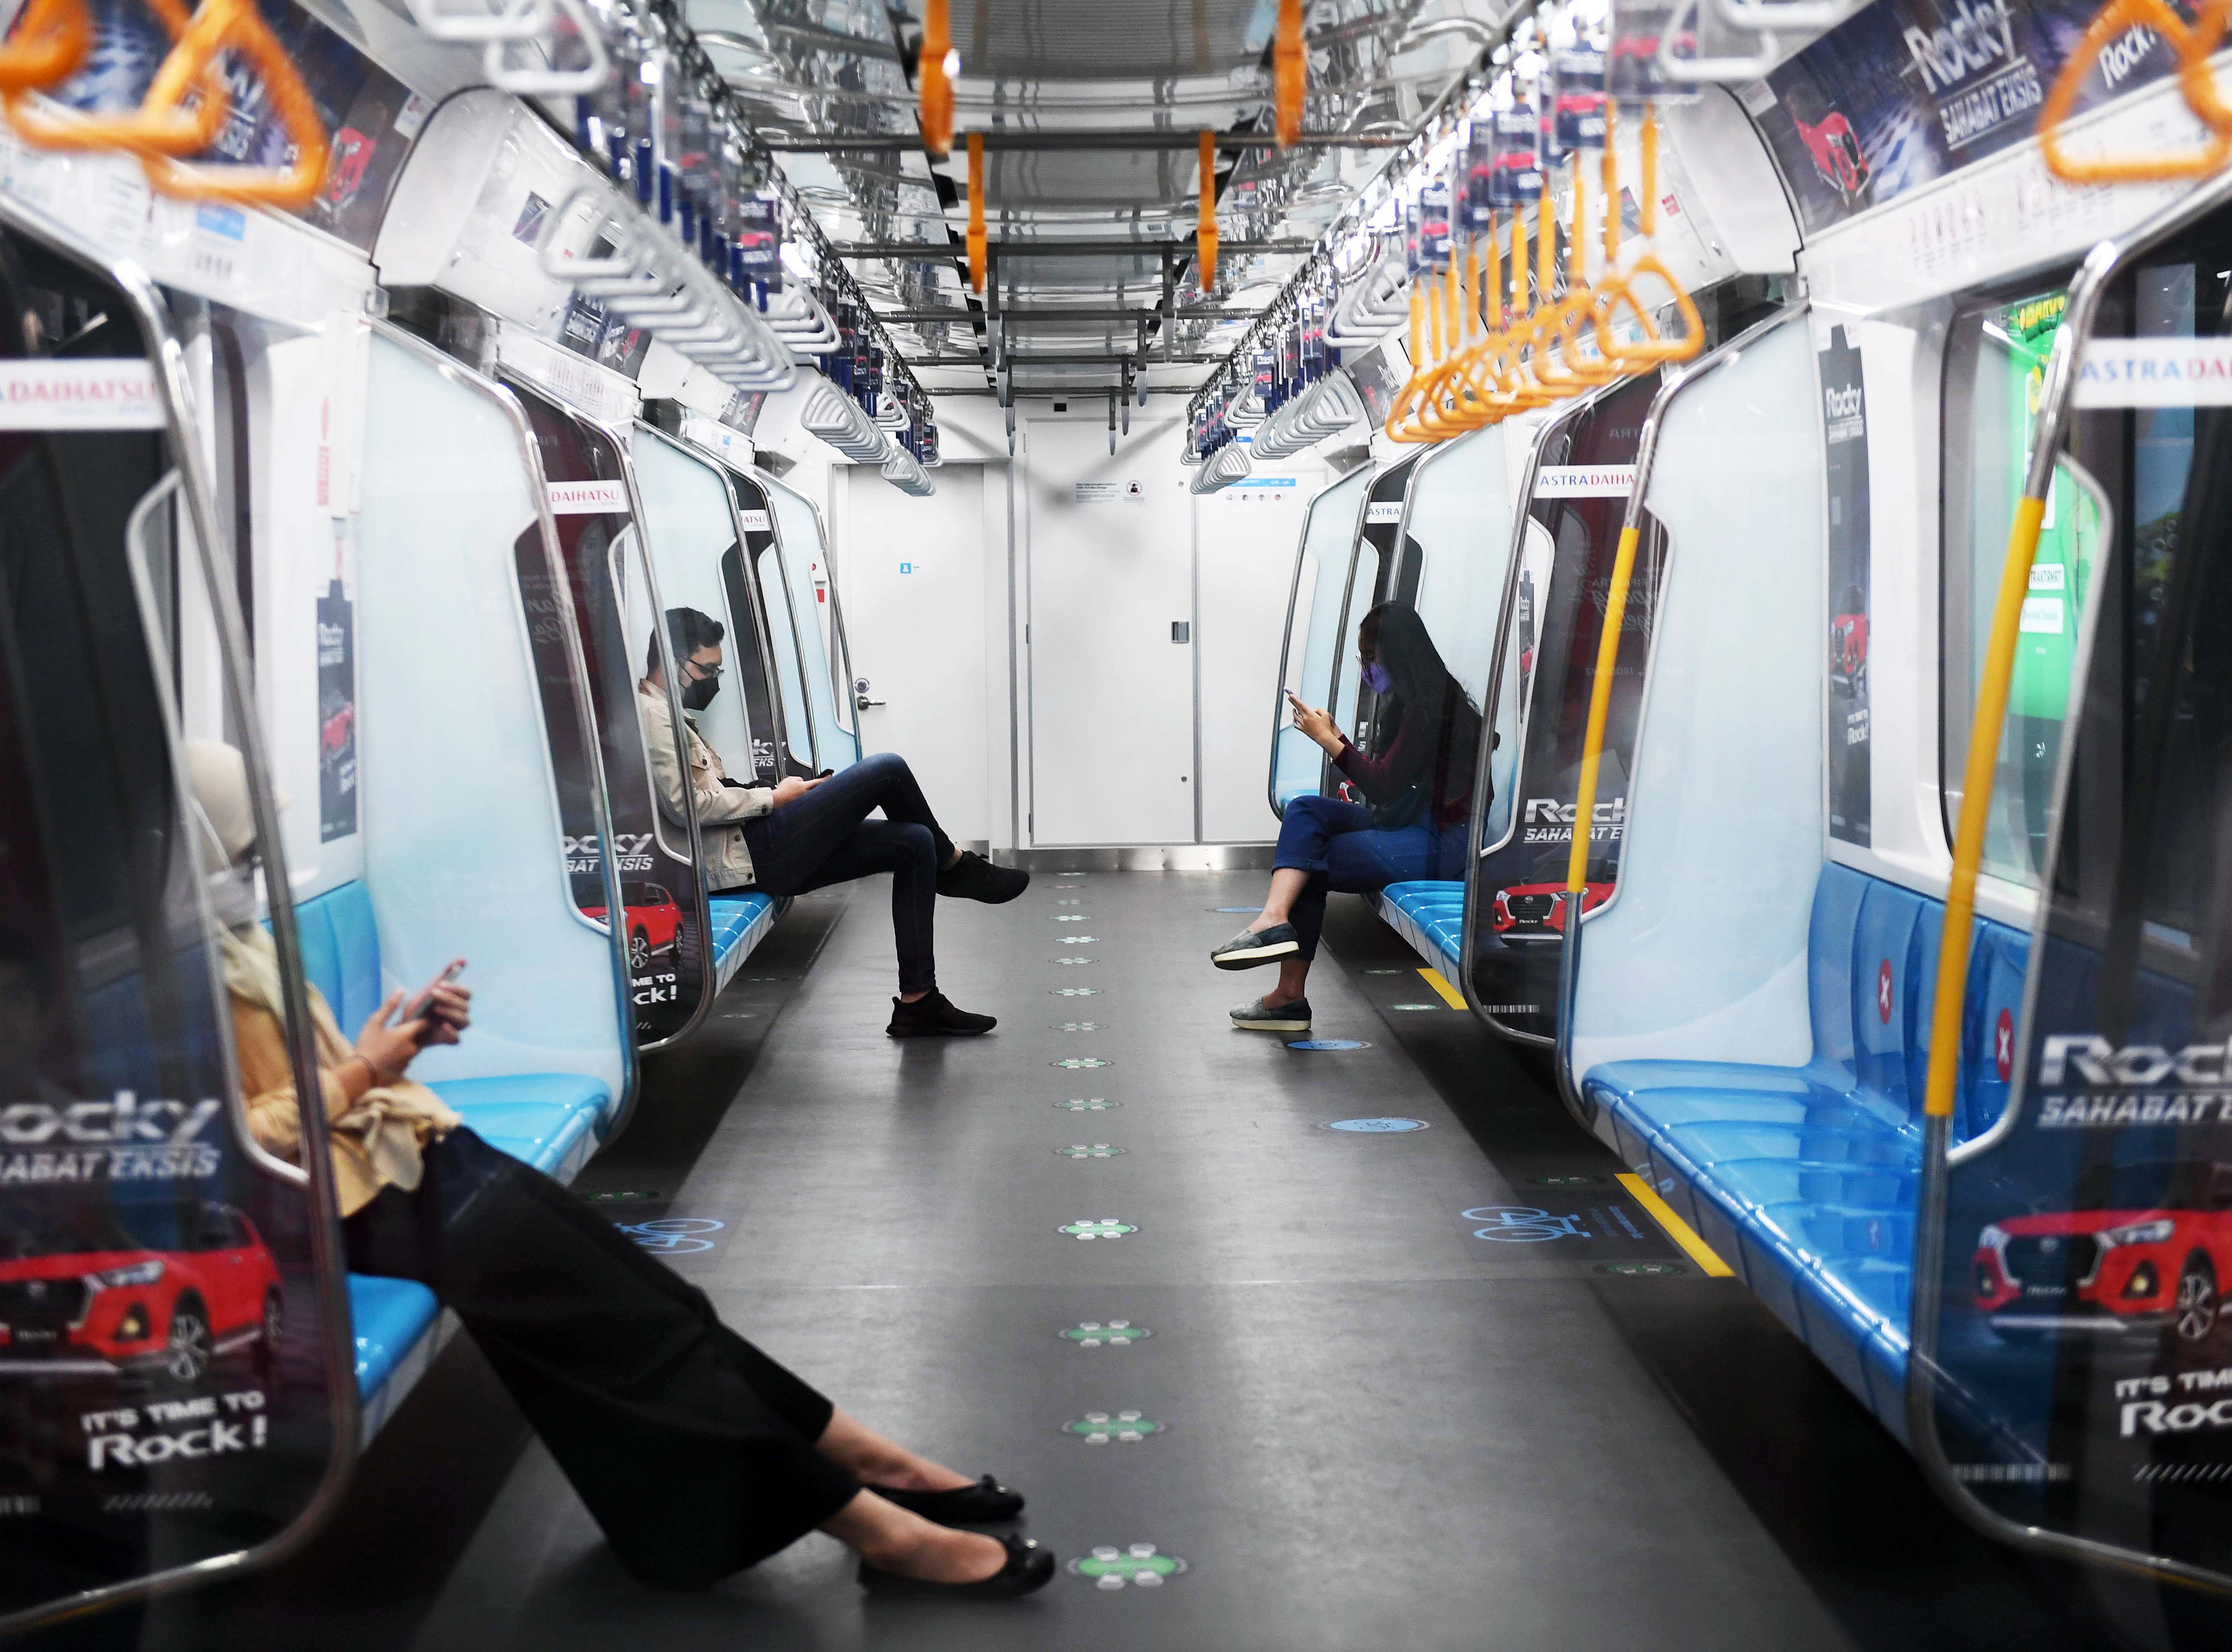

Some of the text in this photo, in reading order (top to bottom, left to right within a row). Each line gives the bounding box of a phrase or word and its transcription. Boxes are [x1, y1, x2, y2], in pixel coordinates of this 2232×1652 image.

[551, 490, 619, 502] DAIHATSU
[656, 973, 676, 983] TO
[2037, 1095, 2216, 1129] SAHABAT
[109, 1147, 223, 1181] EKSIS
[2115, 1376, 2171, 1399] IT'S
[81, 1389, 266, 1432] IT'S TIME TO
